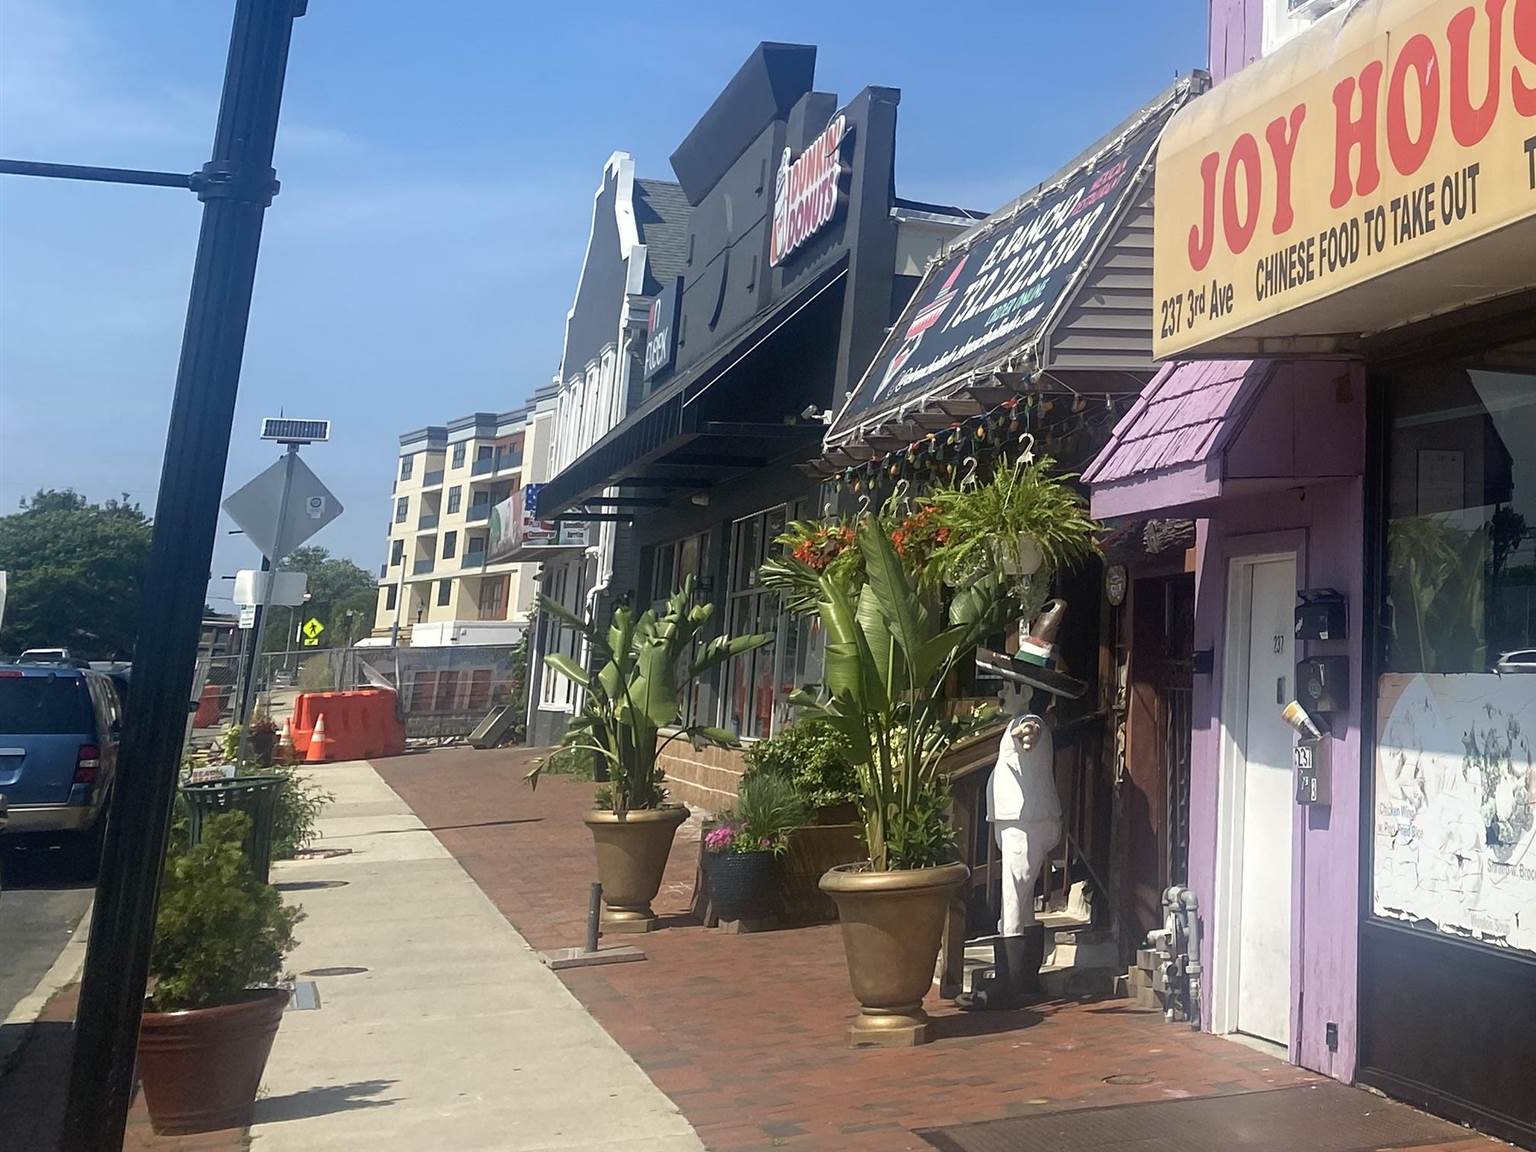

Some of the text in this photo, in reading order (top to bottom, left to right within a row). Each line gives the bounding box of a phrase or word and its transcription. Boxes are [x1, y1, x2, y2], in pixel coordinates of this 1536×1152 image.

[787, 169, 836, 250] DONUTS
[1188, 104, 1306, 272] JOY
[977, 186, 1087, 276] EL RANCHO
[1255, 164, 1480, 302] CHINESE FOOD TO TAKE OUT
[1161, 279, 1234, 339] 237 3rd Ave
[1273, 634, 1285, 654] 237
